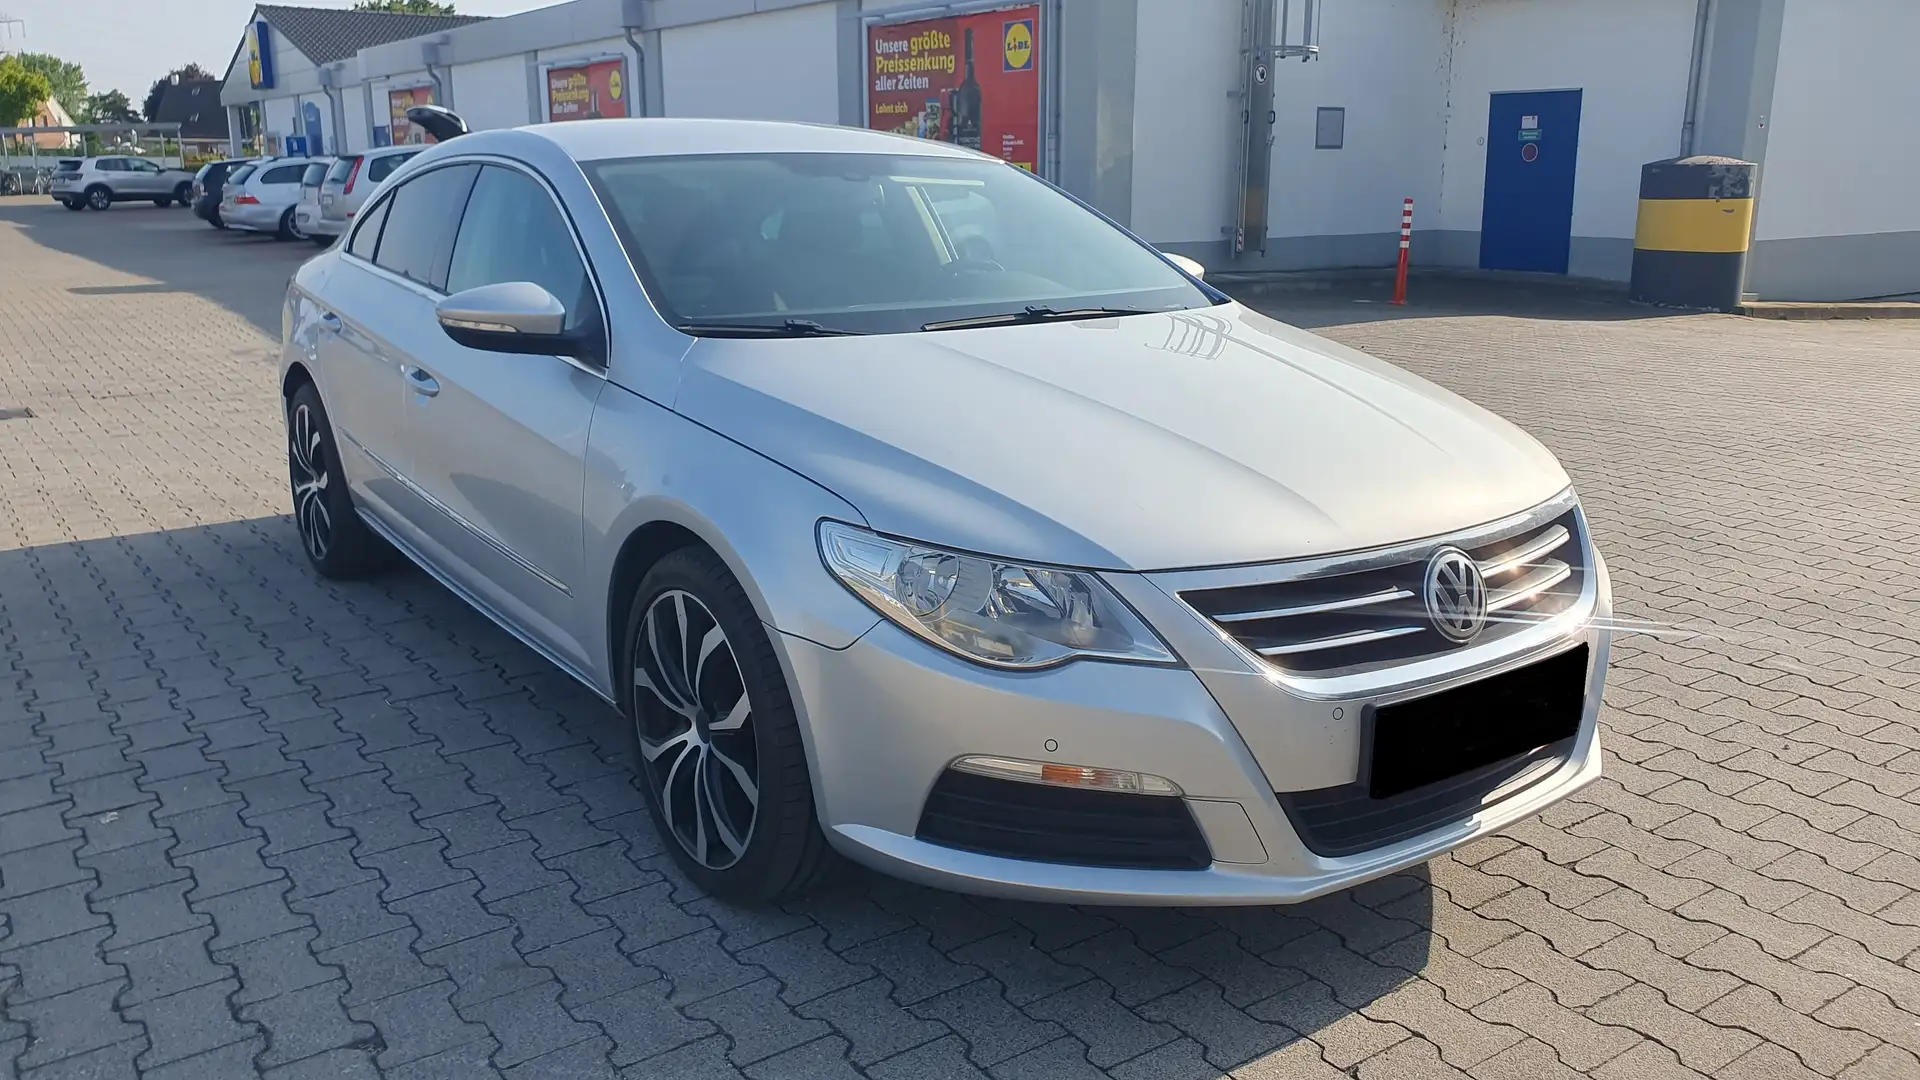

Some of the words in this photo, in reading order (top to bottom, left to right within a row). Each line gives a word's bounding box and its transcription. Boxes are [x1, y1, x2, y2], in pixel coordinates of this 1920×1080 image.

[875, 39, 908, 54] Unsere
[910, 30, 951, 56] größte
[875, 51, 955, 74] Preissenkung
[875, 75, 896, 91] aller
[897, 72, 929, 90] Zeiten
[875, 103, 894, 114] Lohnt
[894, 101, 908, 113] sich
